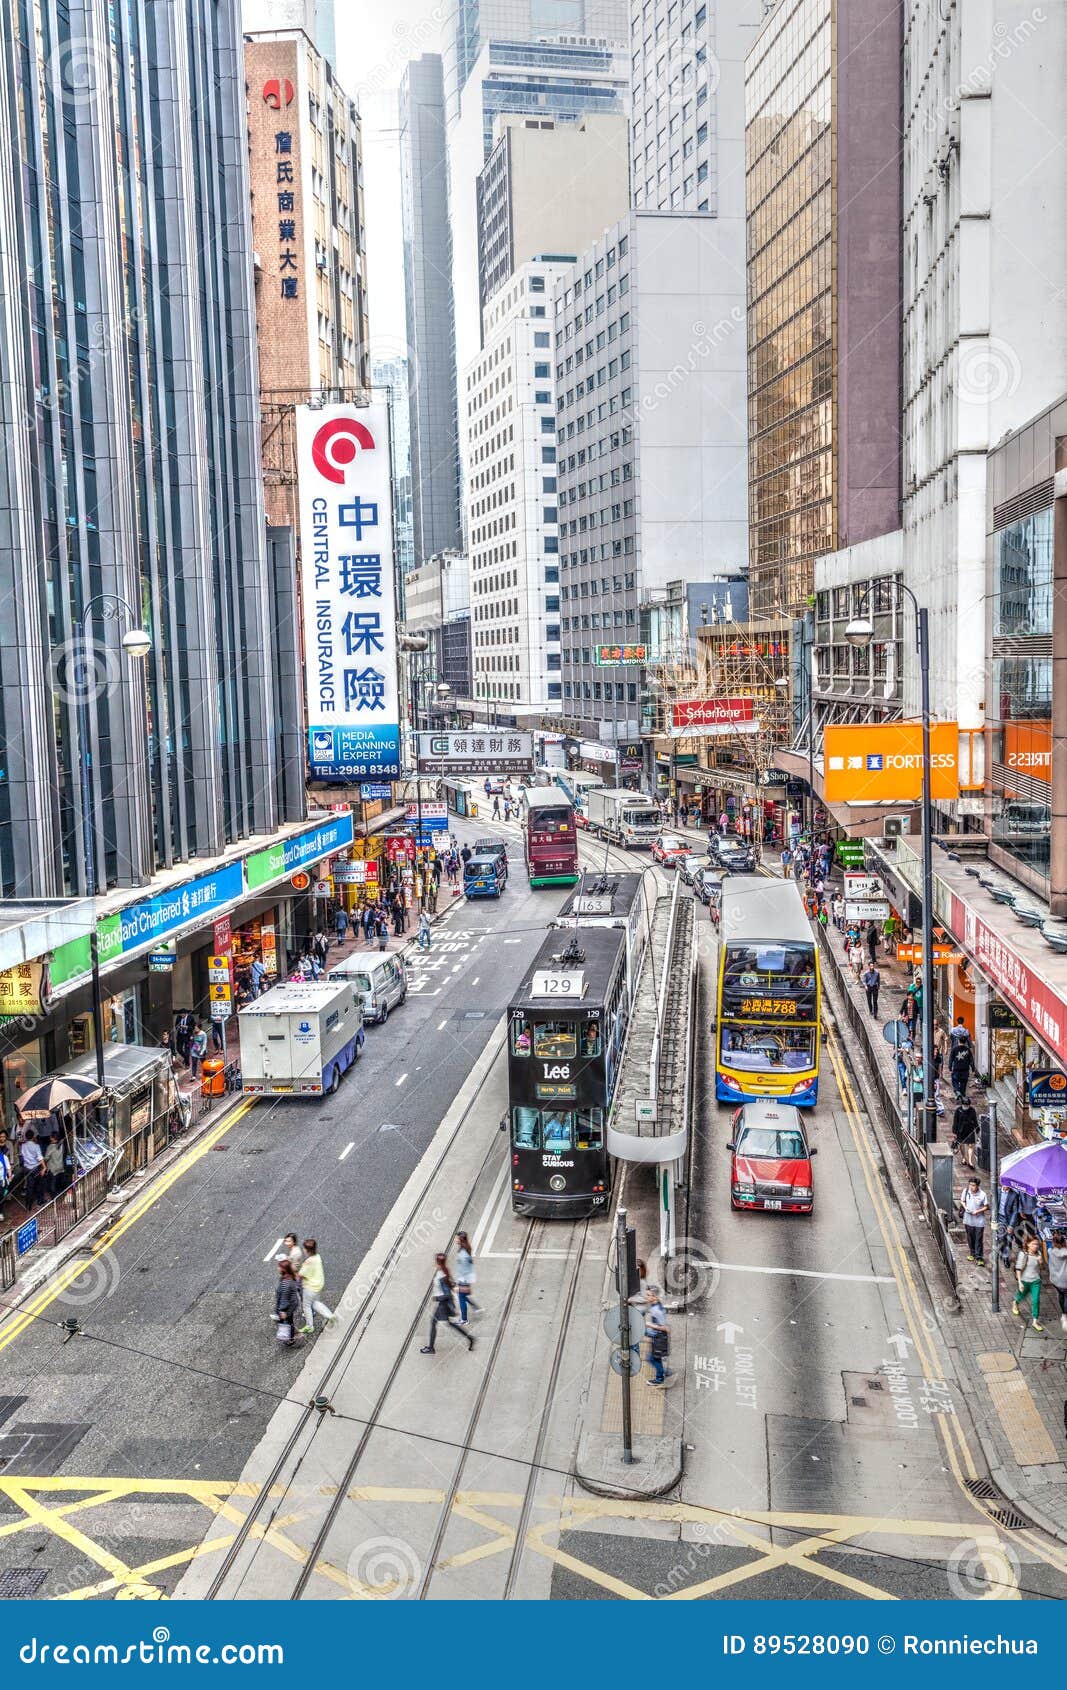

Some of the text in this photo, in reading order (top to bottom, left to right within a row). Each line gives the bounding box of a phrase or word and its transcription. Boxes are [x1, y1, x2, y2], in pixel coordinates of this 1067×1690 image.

[311, 497, 335, 713] CENTRAL INSURANCE
[338, 495, 386, 713] 中環保險
[342, 731, 375, 740] MEDIA
[342, 741, 396, 750] PLANNING
[453, 738, 521, 753] 領達財務
[343, 751, 382, 760] EXPERT
[886, 753, 955, 769] FORTESS
[369, 765, 398, 774] 8348
[269, 839, 317, 871] Standard Chartered
[583, 901, 602, 911] 163
[97, 899, 181, 953] Standard Chartered
[430, 931, 474, 940] BUS
[543, 980, 571, 993] 129
[587, 1010, 600, 1018] 129
[773, 1003, 796, 1013] 788
[543, 1063, 570, 1079] Lee
[592, 1196, 605, 1204] 129
[734, 1346, 757, 1409] LOOK LEFT
[892, 1394, 918, 1429] LOOK
